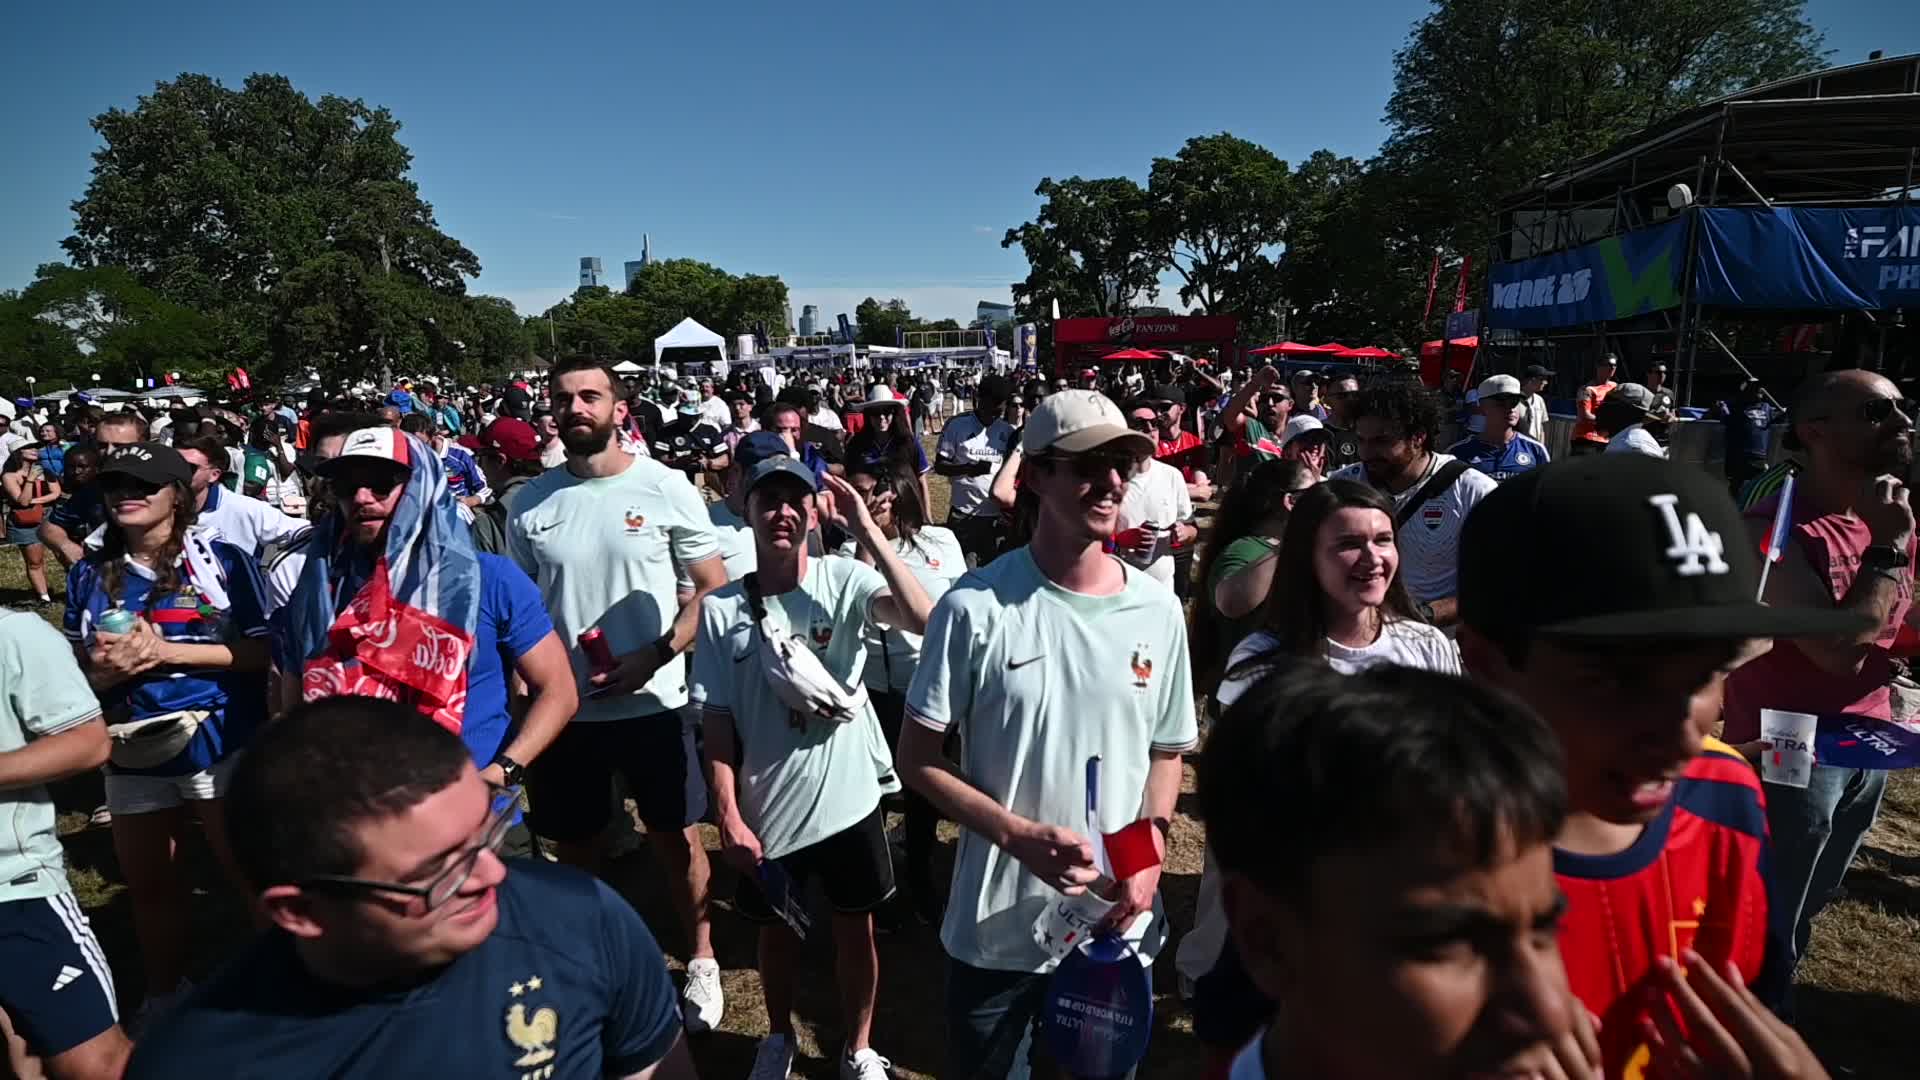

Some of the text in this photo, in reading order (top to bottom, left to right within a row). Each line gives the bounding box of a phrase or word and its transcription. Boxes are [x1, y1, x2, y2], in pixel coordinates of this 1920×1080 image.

[115, 446, 153, 461] PARIS
[1649, 493, 1729, 575] LA
[1844, 723, 1897, 756] ULTRA
